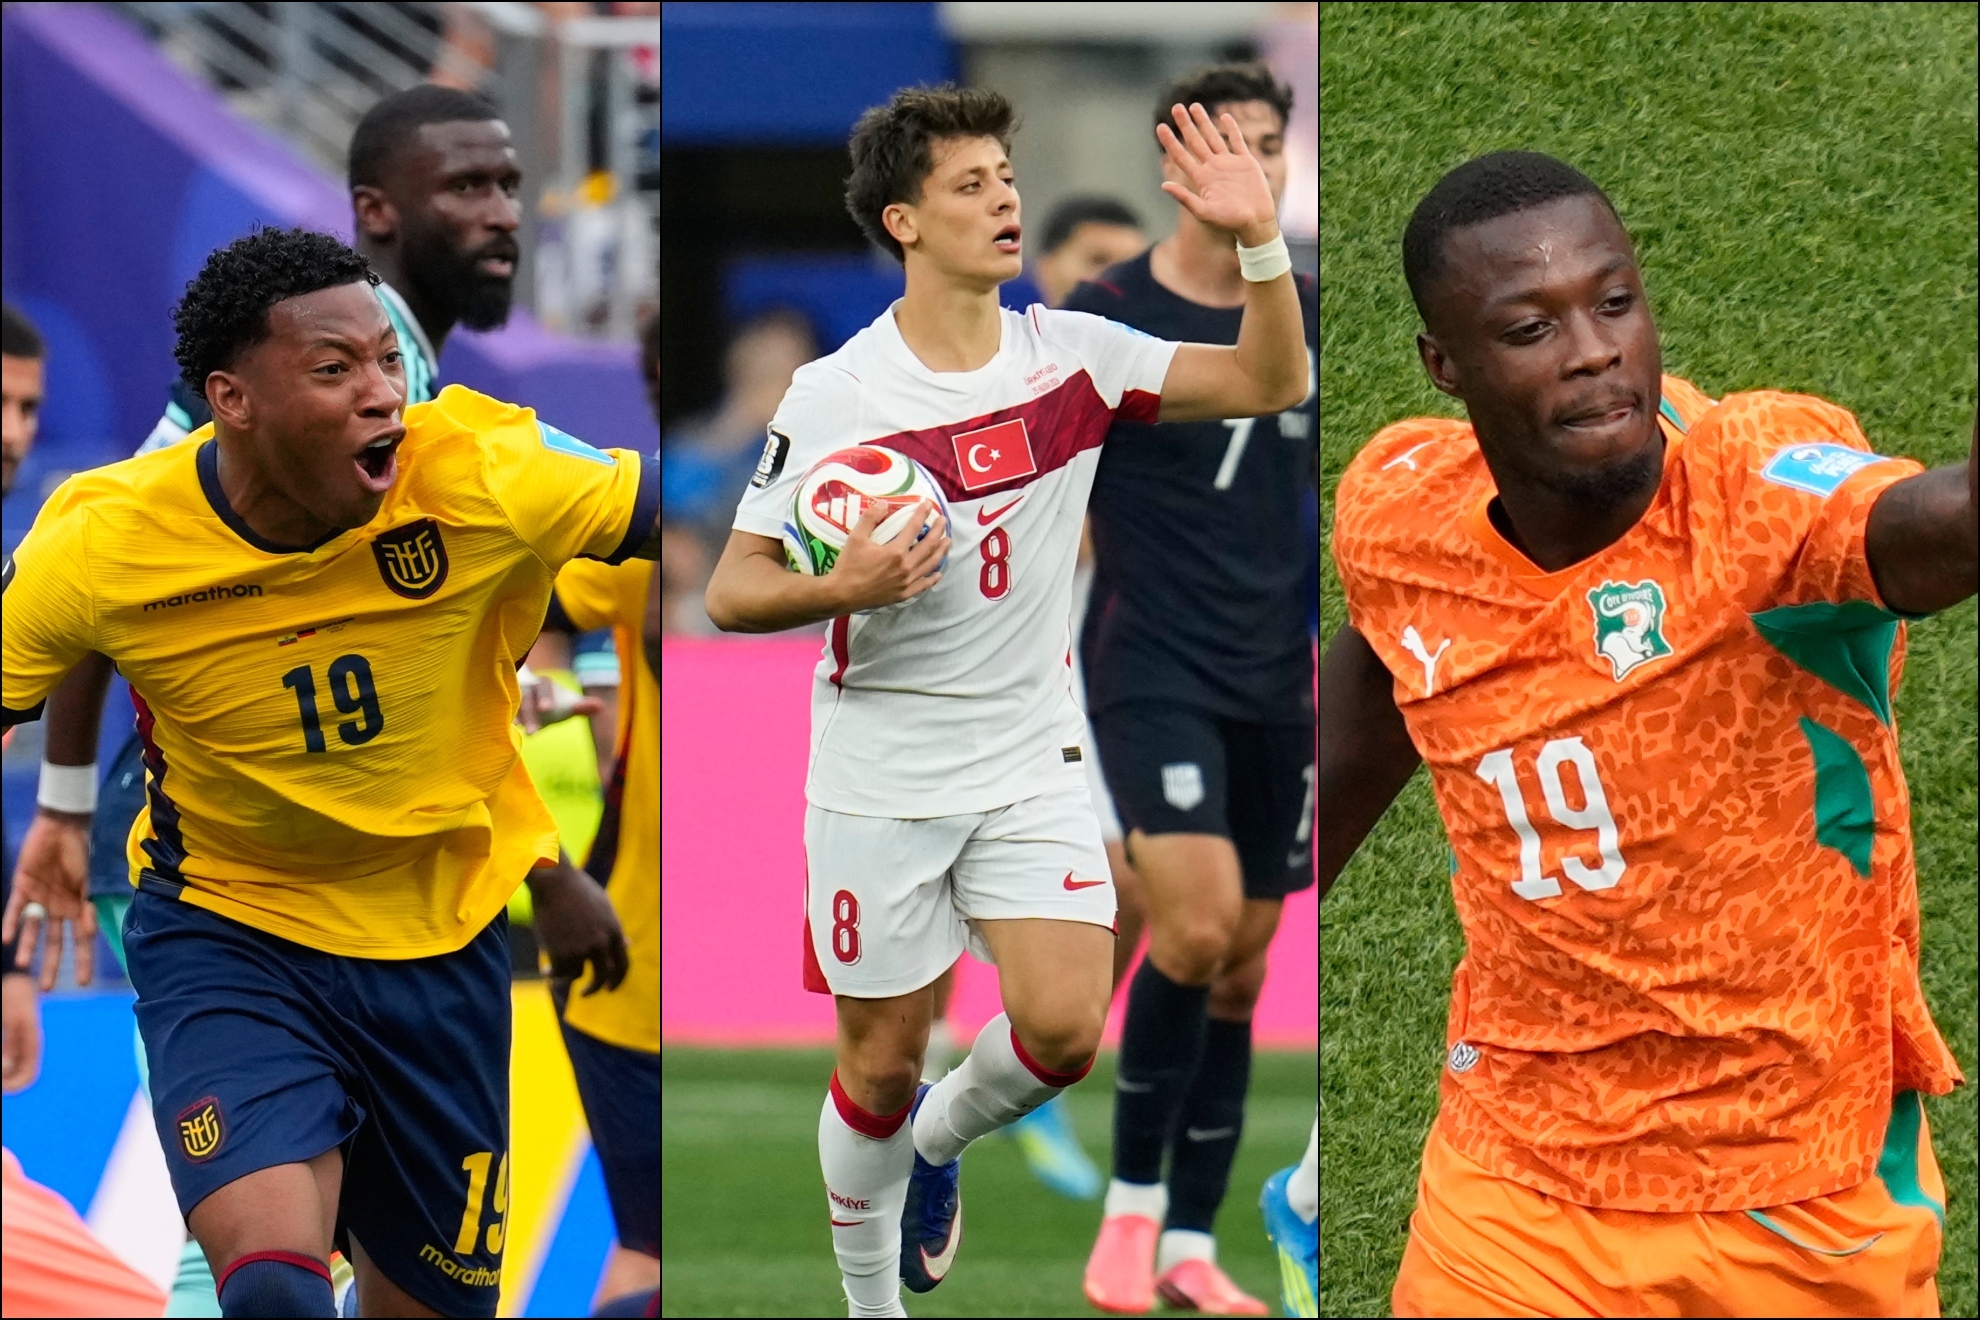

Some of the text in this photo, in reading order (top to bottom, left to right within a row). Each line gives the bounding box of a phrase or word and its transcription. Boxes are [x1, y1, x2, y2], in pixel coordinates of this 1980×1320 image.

[1213, 417, 1256, 491] 7
[143, 583, 264, 612] marathon
[979, 526, 1012, 602] 8
[281, 653, 385, 753] 19
[1475, 735, 1627, 901] 19
[832, 889, 862, 966] 8
[454, 1150, 508, 1255] 19
[826, 1189, 871, 1210] RKİYE
